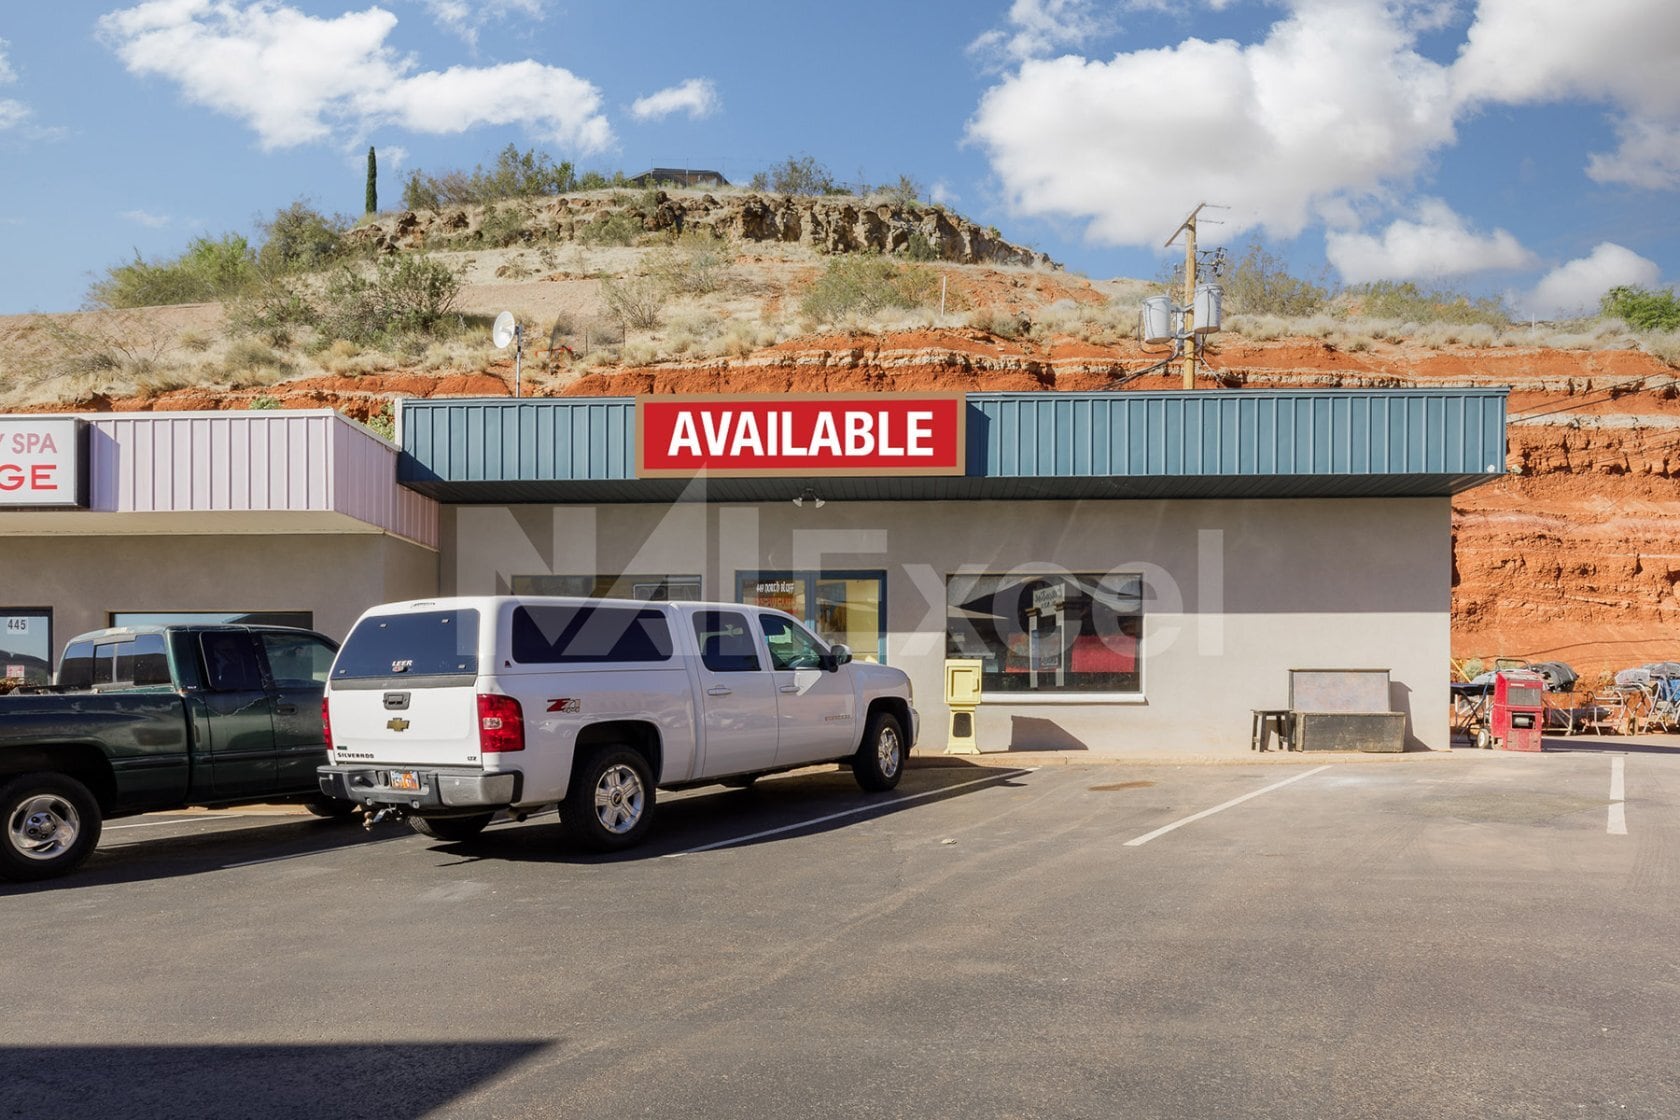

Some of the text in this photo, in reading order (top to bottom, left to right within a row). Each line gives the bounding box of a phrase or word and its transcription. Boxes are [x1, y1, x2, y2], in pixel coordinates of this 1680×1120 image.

[12, 432, 58, 454] SPA
[667, 410, 934, 456] AVAILABLE
[7, 619, 26, 630] 445
